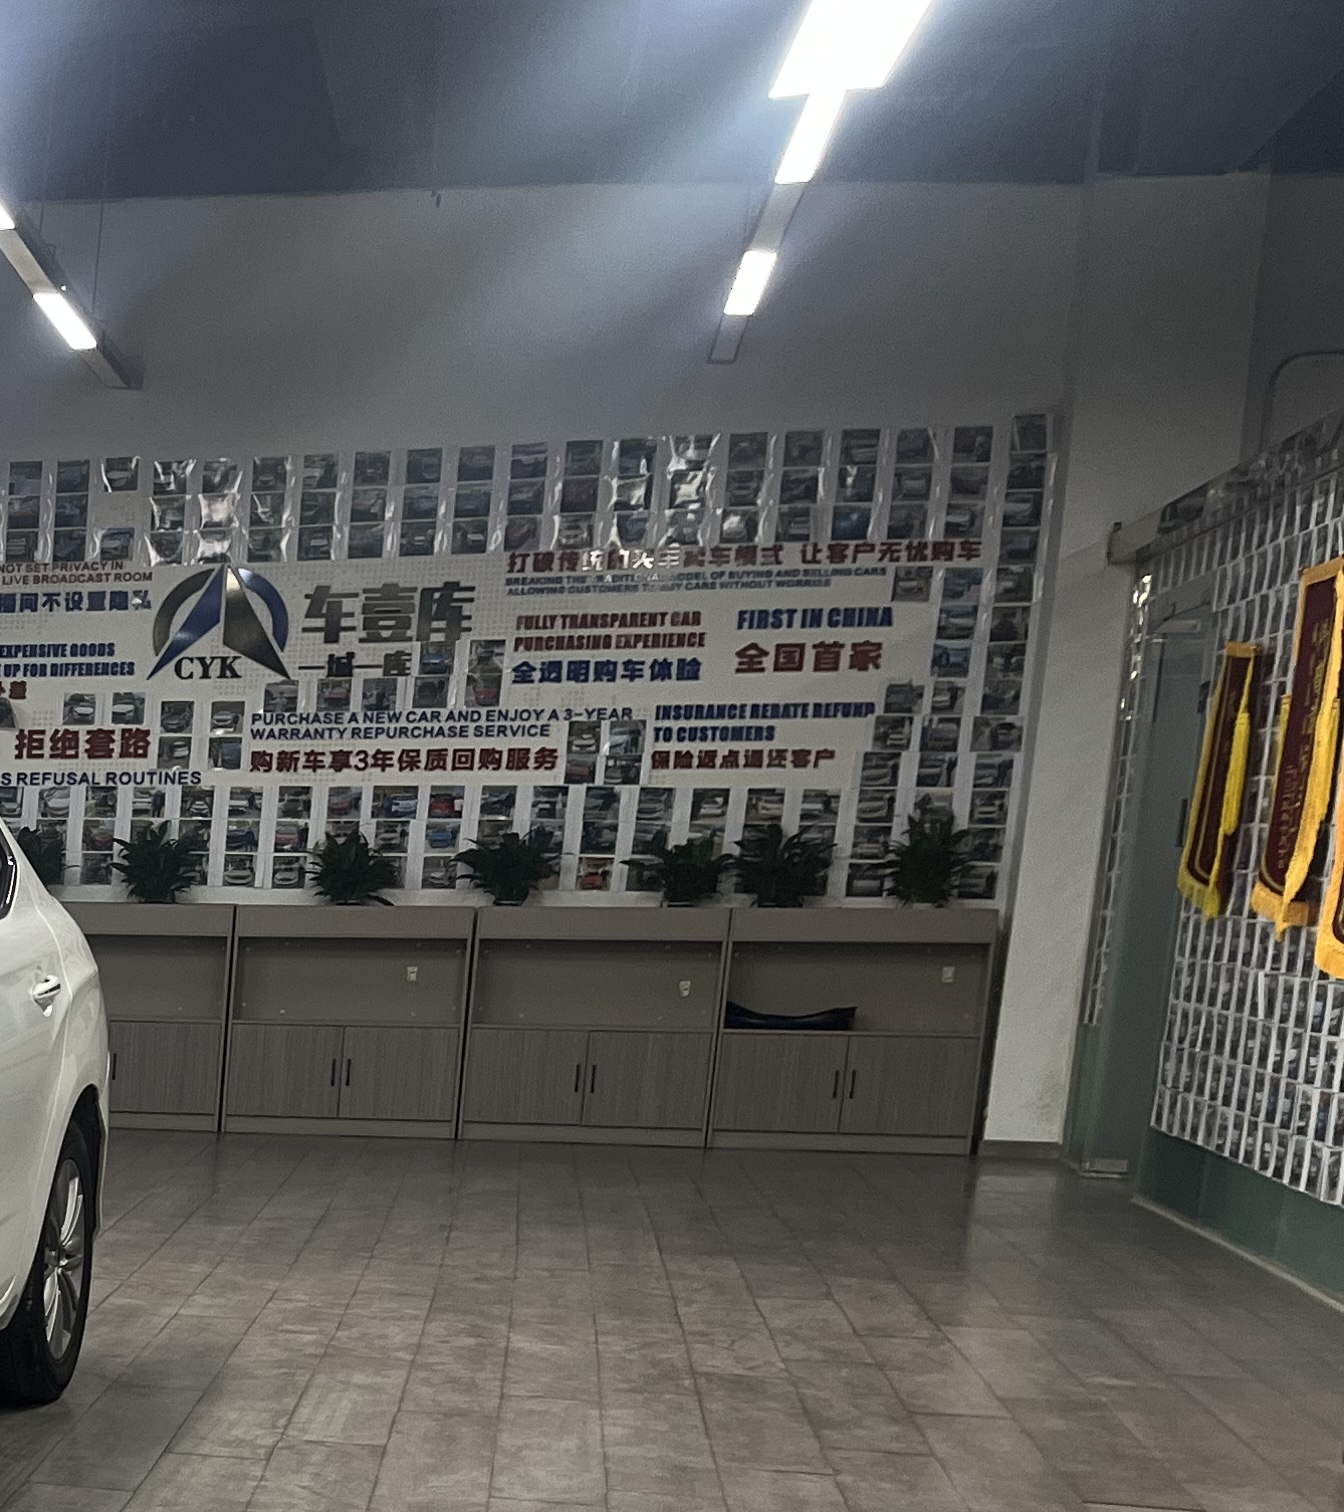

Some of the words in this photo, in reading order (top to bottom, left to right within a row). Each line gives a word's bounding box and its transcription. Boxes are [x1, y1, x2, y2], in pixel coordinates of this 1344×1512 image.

[800, 539, 982, 565] 让客户无忧购车
[25, 563, 50, 573] SET
[52, 562, 109, 573] PRIVACY
[111, 561, 124, 570] IN
[775, 568, 801, 578] AND
[854, 567, 887, 576] CARS
[2, 575, 30, 586] LIVE
[32, 573, 112, 585] BROADCAST
[113, 572, 153, 583] ROOM
[301, 580, 477, 644] 车壹库
[516, 613, 558, 631] FULLY
[561, 611, 669, 629] TRANSPARENT
[670, 610, 702, 627] CAR
[737, 608, 798, 630] FIRST
[800, 608, 824, 629] IN
[827, 606, 894, 628] CHINA
[69, 642, 116, 657] GOODS
[514, 634, 613, 652] PURCHASING
[615, 632, 707, 650] EXPERIENCE
[734, 640, 884, 674] 全国首家
[3, 663, 22, 678] UP
[23, 663, 48, 678] FOR
[50, 662, 136, 677] DIFFERENCES
[174, 655, 243, 681] CYK
[512, 657, 703, 684] 全透明购车体验
[251, 711, 344, 726] PURCHASE
[347, 711, 360, 724] A
[362, 711, 403, 724] NEW
[405, 710, 443, 724] CAR
[445, 709, 482, 723] AND
[486, 708, 545, 723] ENJOY
[547, 708, 560, 722] A
[563, 707, 633, 721] 3-YEAR
[655, 703, 748, 720] INSURANCE
[750, 702, 810, 719] REBATE
[250, 726, 348, 741] WARRANTY
[350, 725, 469, 740] REPURCHASE
[473, 723, 552, 738] SERVICE
[653, 726, 673, 742] TO
[676, 725, 776, 742] CUSTOMERS
[14, 728, 152, 760] 拒绝套路
[249, 746, 559, 773] 购新车享3年保质回购服务
[651, 748, 836, 770] 保险返点退还客户
[16, 772, 101, 786] REFUSAL
[105, 771, 202, 785] ROUTINES
